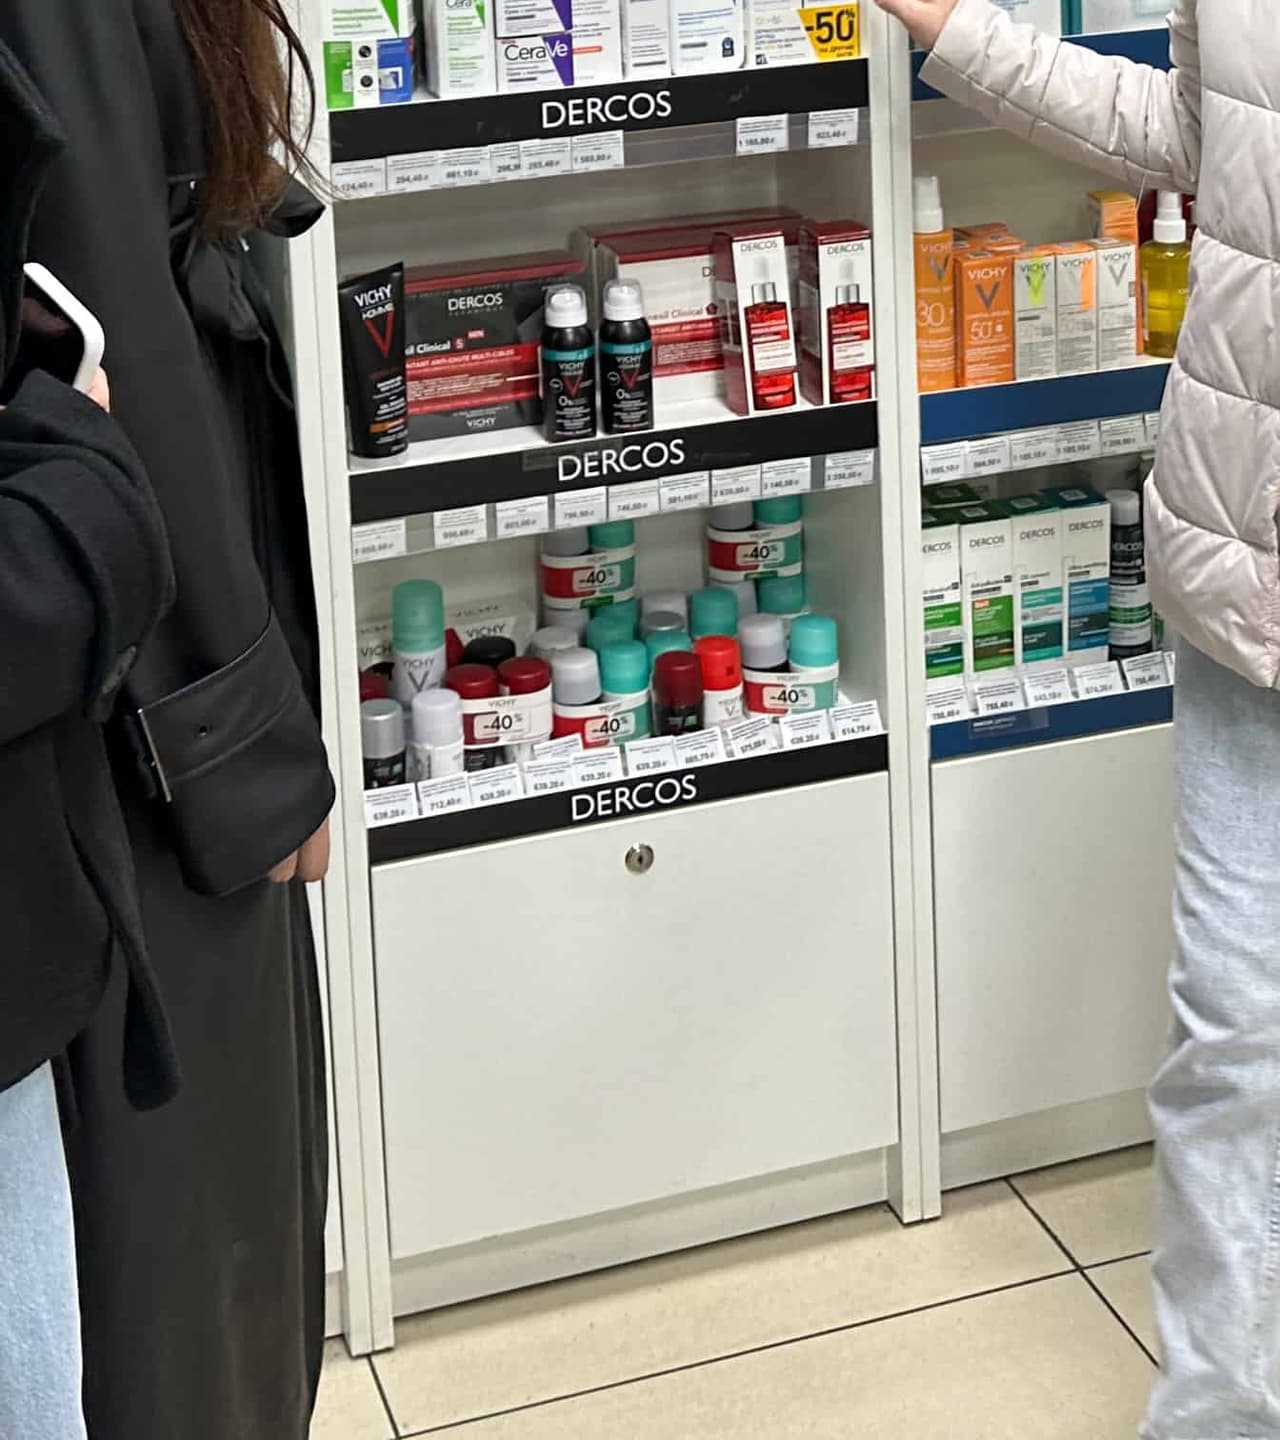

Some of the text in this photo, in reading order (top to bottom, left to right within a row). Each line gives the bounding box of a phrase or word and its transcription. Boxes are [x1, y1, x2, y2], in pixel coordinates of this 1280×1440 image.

[504, 41, 568, 61] CeraVe
[542, 91, 672, 129] DERCOS
[741, 241, 777, 252] DERCOS
[827, 243, 864, 255] DERCOS
[1102, 251, 1132, 262] VICHY
[968, 268, 1007, 278] VICHY
[1021, 262, 1050, 273] VICHY
[355, 284, 392, 306] VICHY
[448, 293, 503, 311] DERCOS
[417, 341, 450, 354] Clinical
[467, 417, 496, 427] VICHY
[558, 440, 685, 483] DERCOS
[1069, 520, 1104, 532] DERCOS
[1020, 529, 1055, 540] DERCOS
[970, 536, 1004, 547] DERCOS
[466, 625, 505, 638] VICHY
[572, 775, 697, 822] DERCOS
